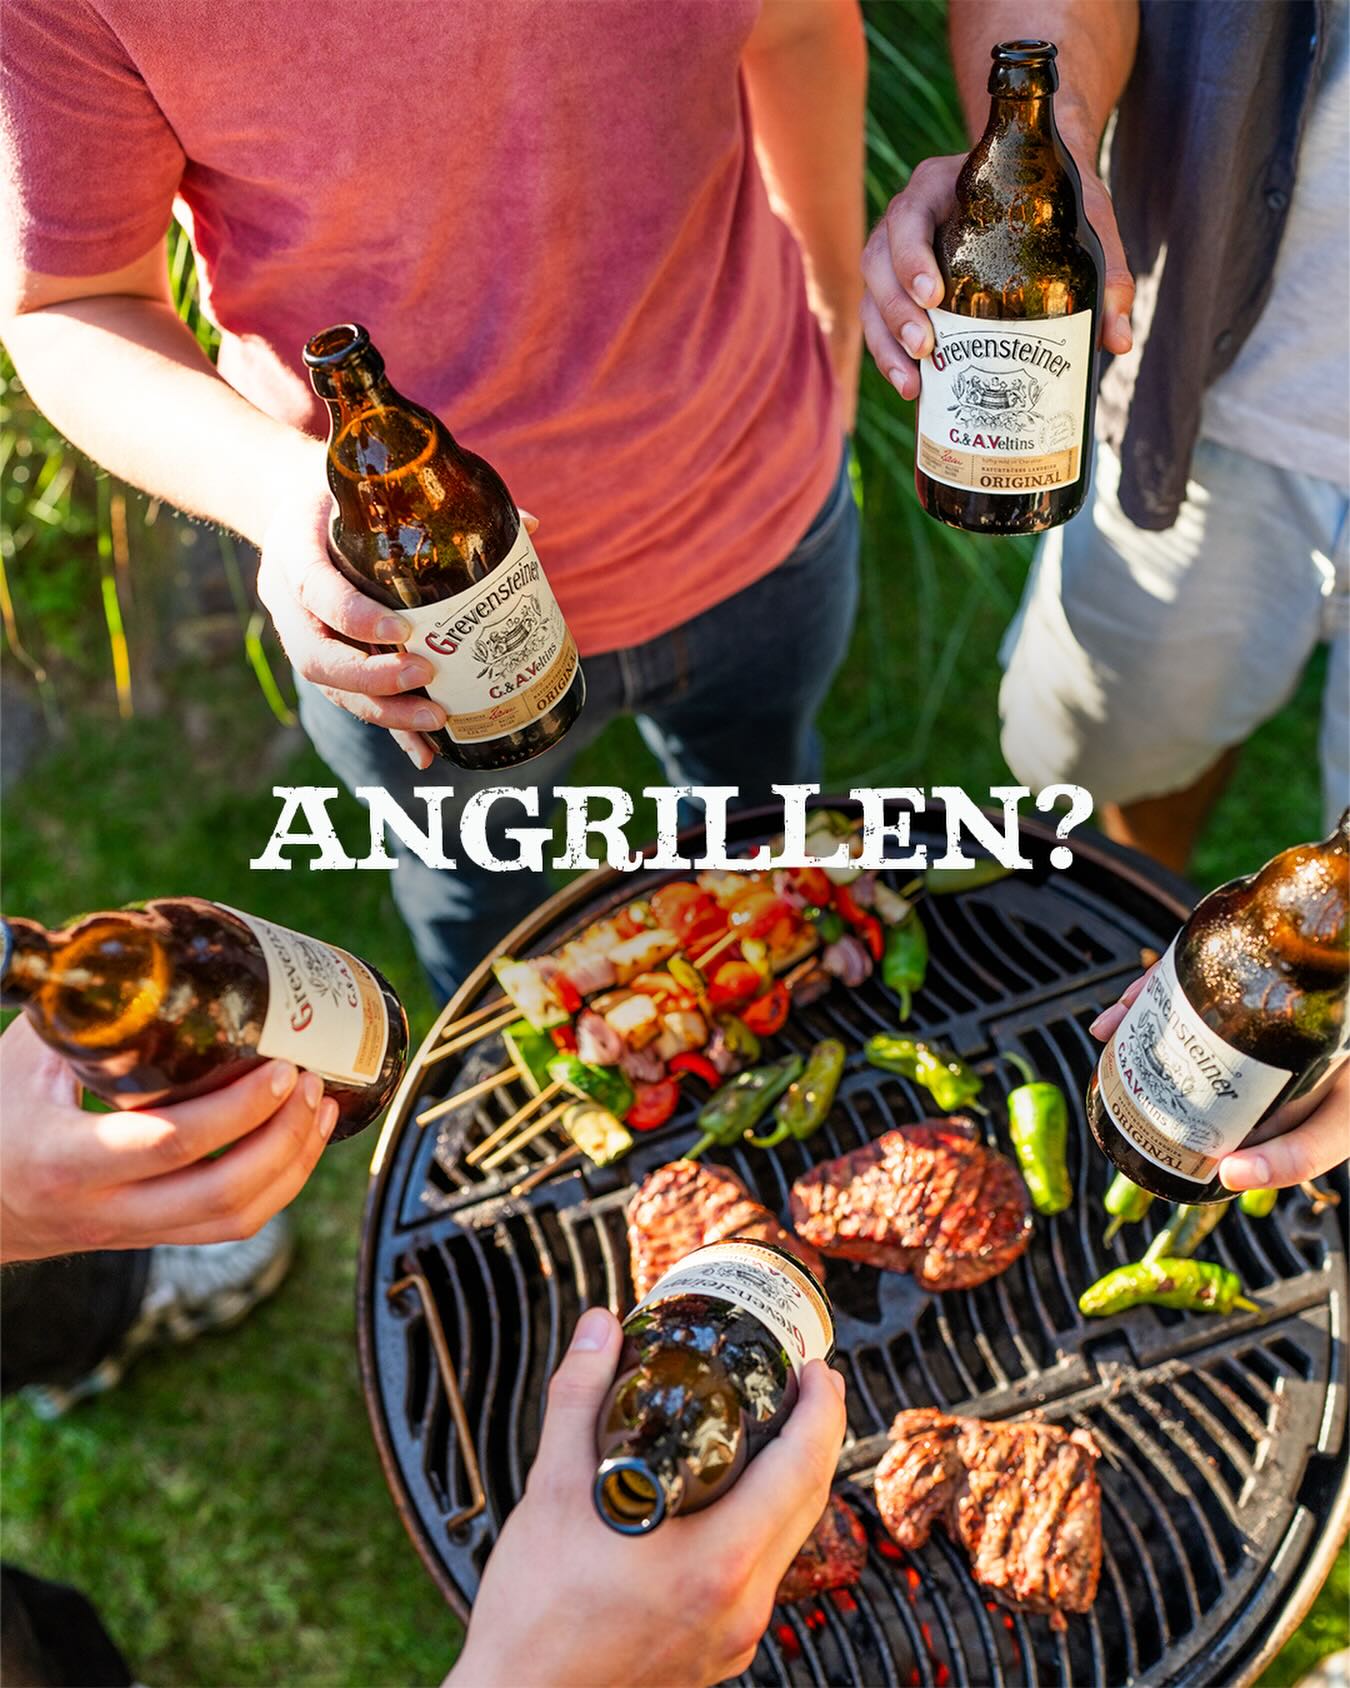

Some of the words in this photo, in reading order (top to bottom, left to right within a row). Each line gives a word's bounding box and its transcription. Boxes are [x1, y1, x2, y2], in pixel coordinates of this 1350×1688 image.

[931, 338, 1072, 378] Grevensteiner
[980, 471, 1062, 489] ORIGINAL
[424, 560, 540, 655] Grevensteiner
[1146, 974, 1239, 1101] Grevensteiner
[1111, 1102, 1183, 1171] ORIGINAL
